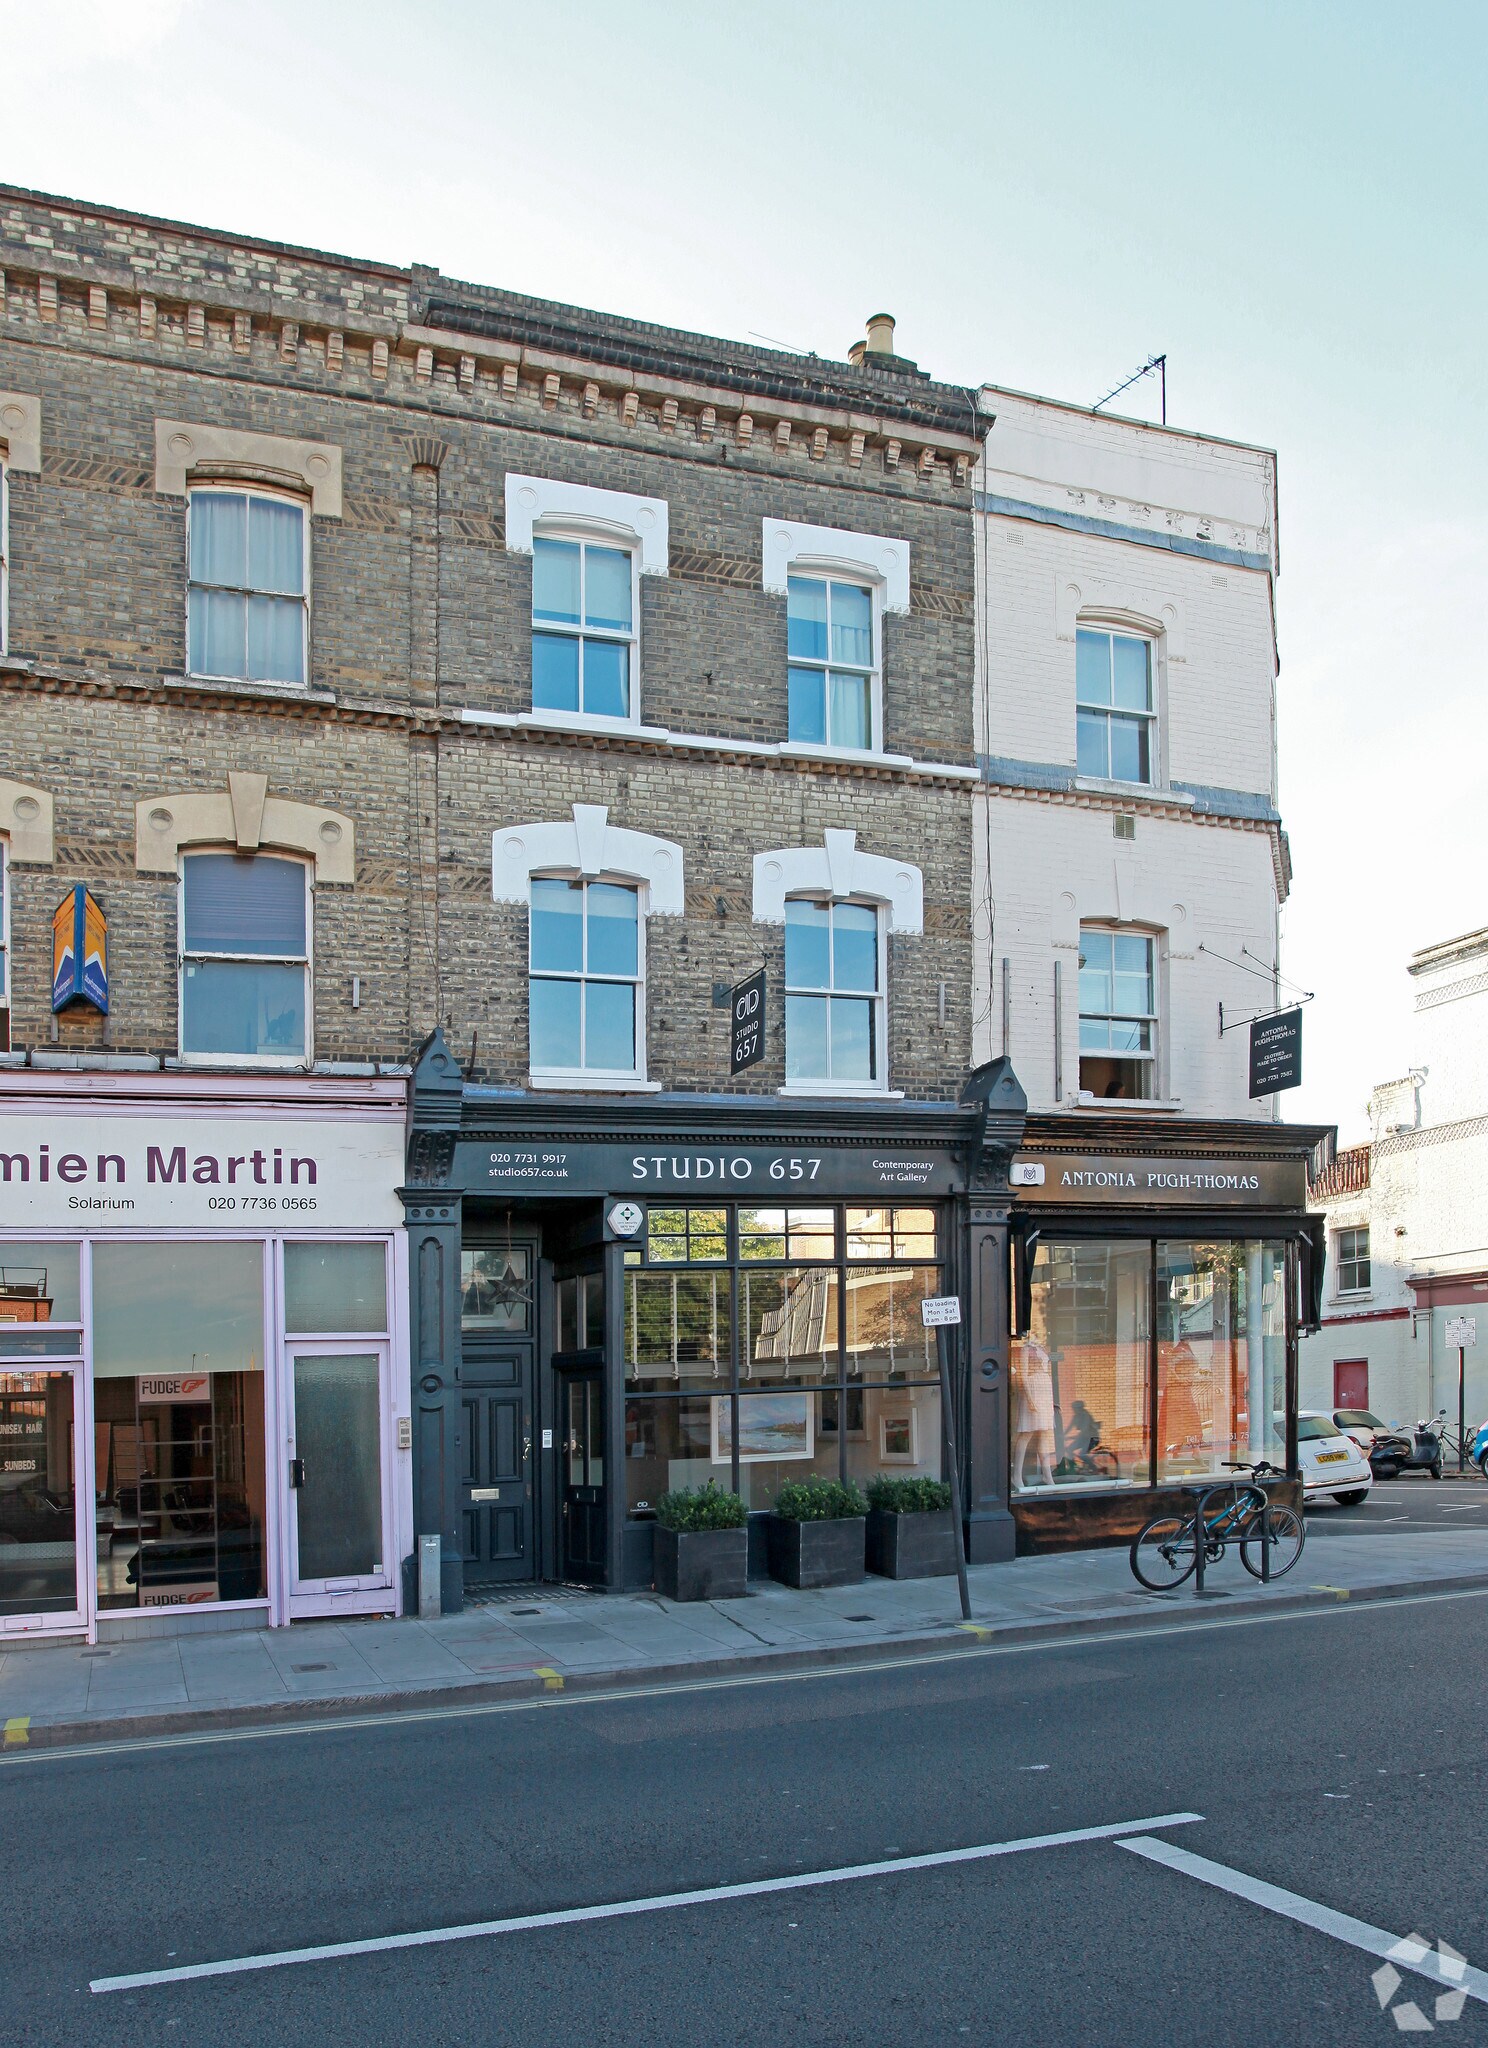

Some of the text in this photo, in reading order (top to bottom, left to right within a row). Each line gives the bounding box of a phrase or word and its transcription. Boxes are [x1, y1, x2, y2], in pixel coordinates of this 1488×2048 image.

[736, 1020, 759, 1040] STUDIO
[1260, 1025, 1288, 1038] ANTONIA
[735, 1034, 758, 1062] 657
[490, 1153, 567, 1164] 020 7731 9917
[146, 1146, 318, 1185] Martin
[488, 1167, 569, 1177] studio657.co.uk
[632, 1156, 821, 1180] STUDIO 657
[872, 1160, 934, 1171] Contemporary
[879, 1173, 928, 1183] Art Gallery
[1060, 1171, 1259, 1190] ANTONIA PUGH-THOMAS
[68, 1196, 317, 1210] Solarium 020 7736 0565
[142, 1380, 180, 1395] FUDGE
[25, 1422, 43, 1434] HAIR
[4, 1459, 36, 1471] SUNBEDS
[144, 1593, 187, 1606] FUDGE
